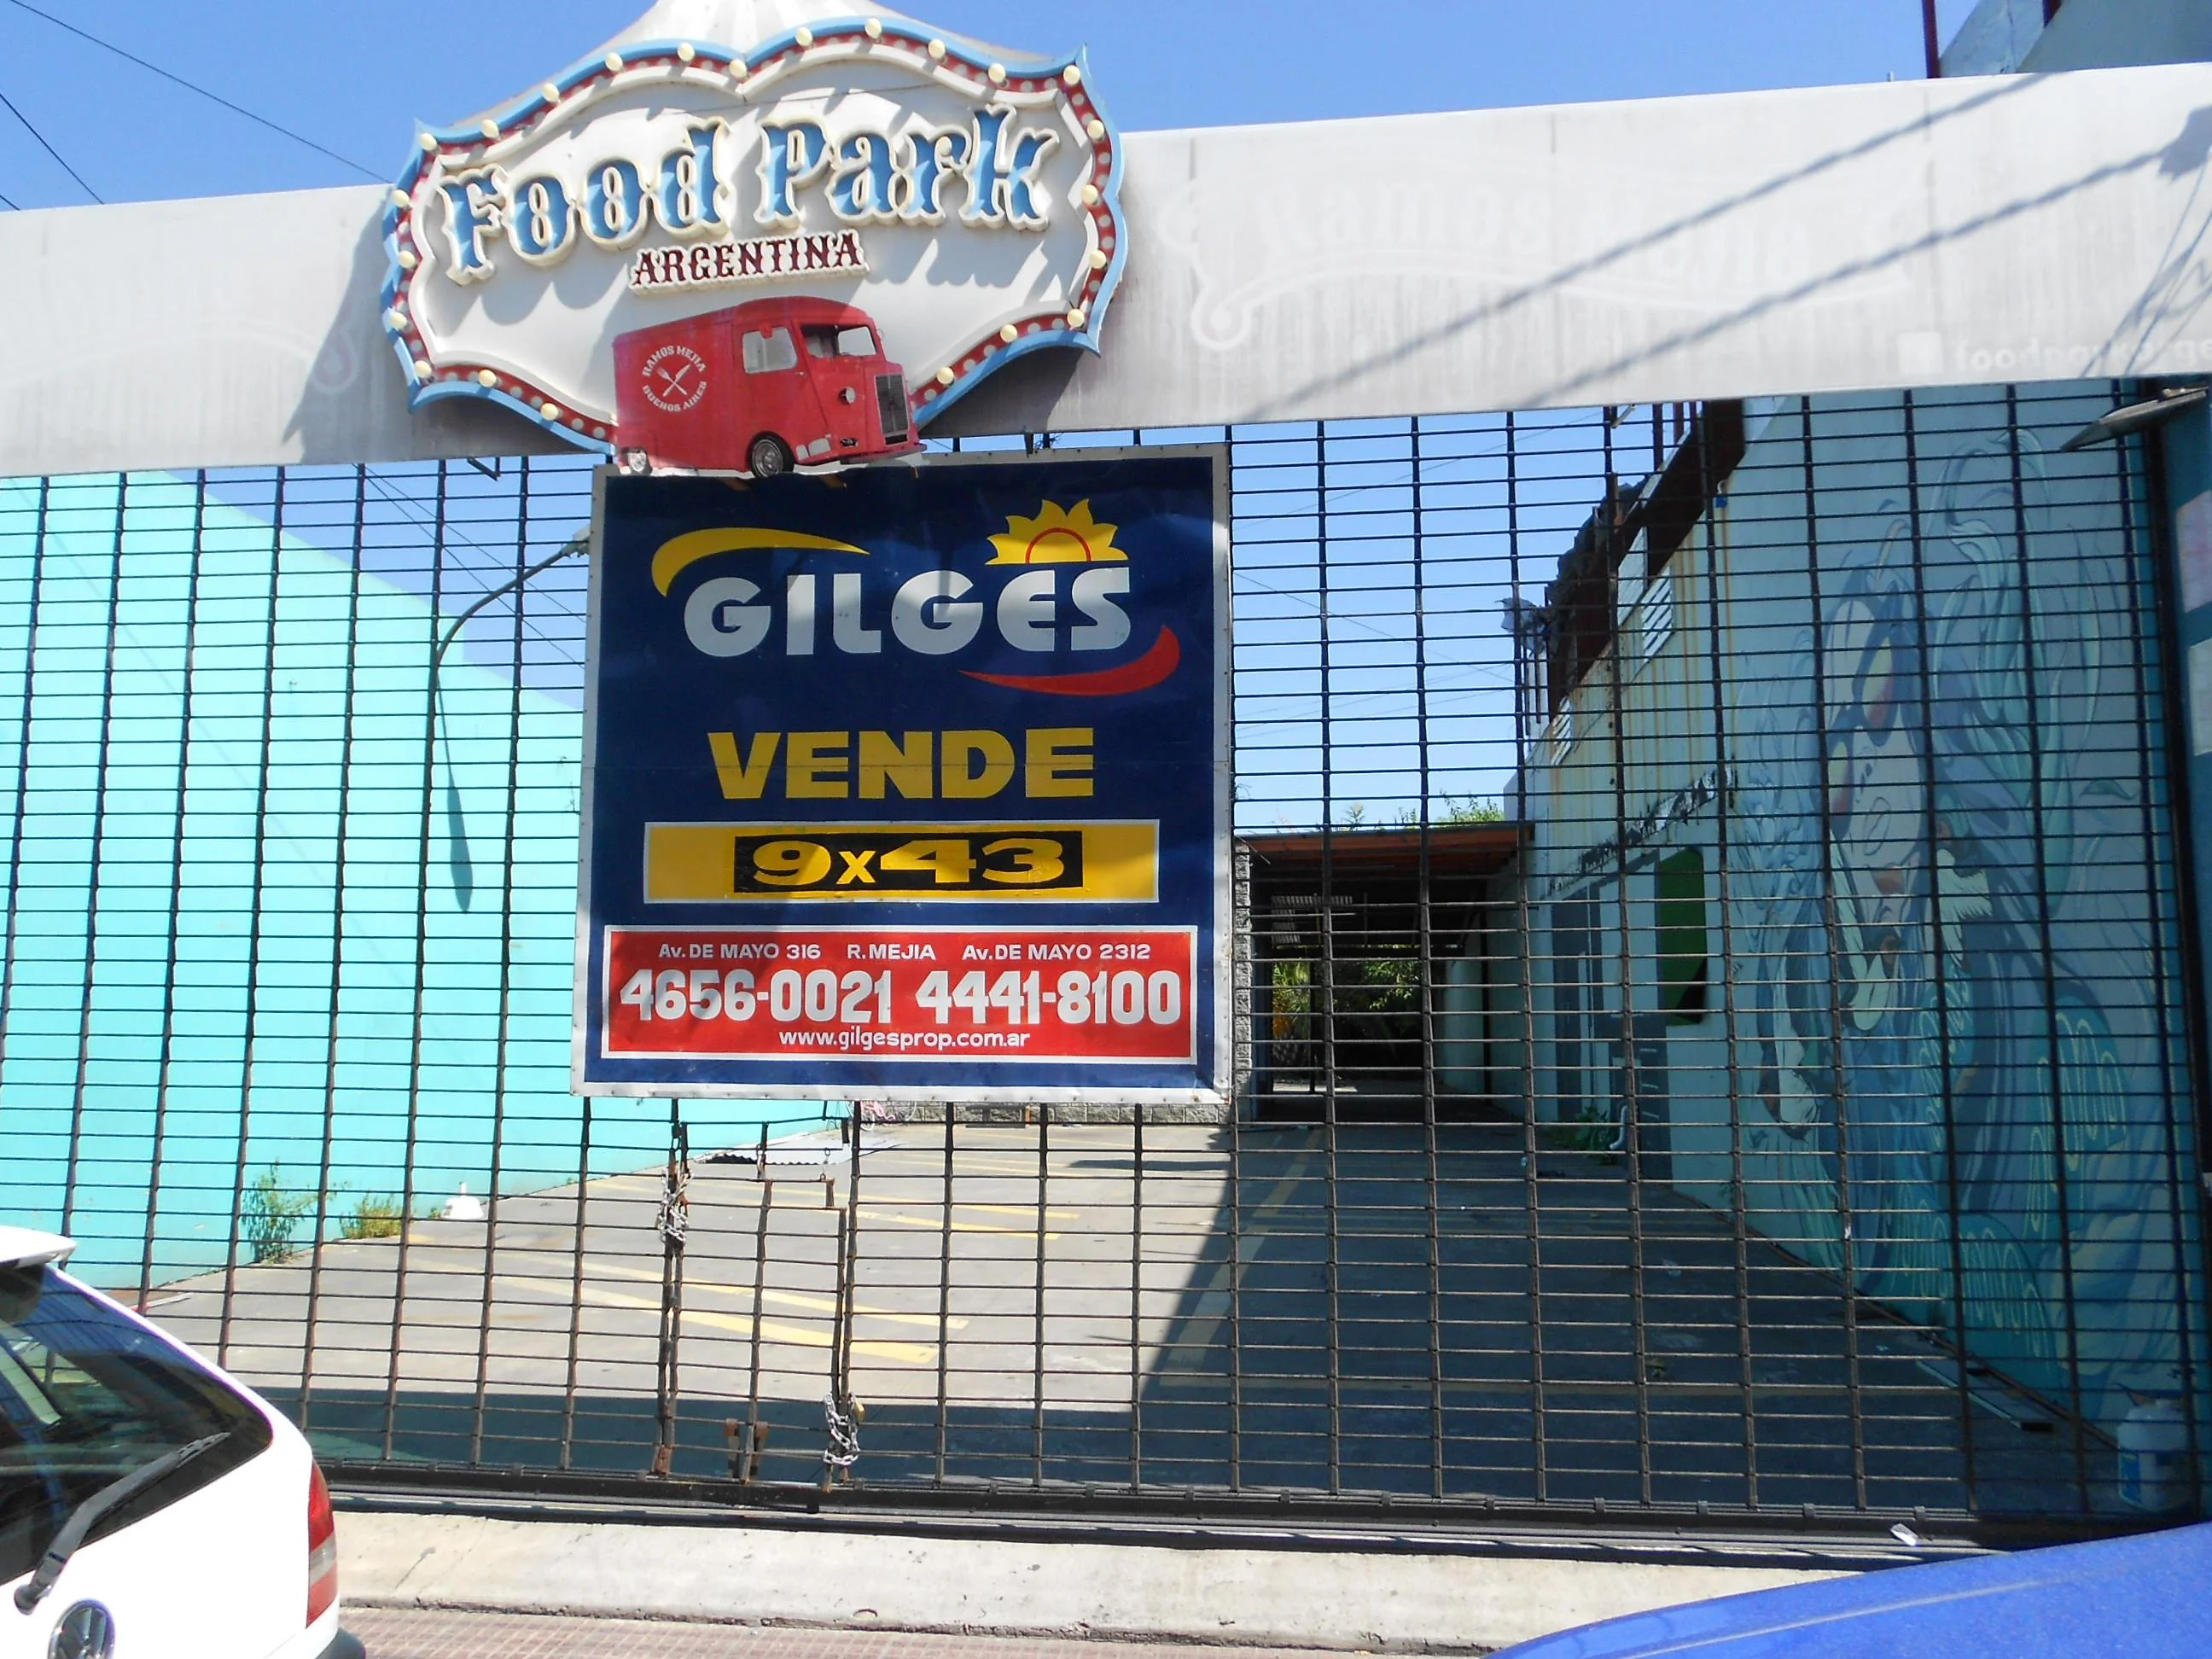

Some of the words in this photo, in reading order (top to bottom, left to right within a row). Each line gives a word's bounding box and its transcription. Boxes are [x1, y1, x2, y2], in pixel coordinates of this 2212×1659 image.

[438, 116, 735, 285] Food
[754, 103, 1060, 231] Park
[632, 230, 867, 290] ARGENTINA
[642, 345, 675, 377] RAMOS
[677, 345, 707, 373] MEJIA
[642, 385, 681, 412] BUENOS
[683, 381, 707, 410] AIRES
[684, 566, 1132, 658] GILGES
[707, 727, 1094, 800] VENDE
[720, 942, 780, 959] MAYO
[786, 943, 821, 960] 316
[1027, 943, 1092, 961] MAYO
[1099, 943, 1151, 960] 2312
[620, 968, 893, 1024] 4656-0021
[915, 969, 1181, 1025] 4441-8100
[778, 1025, 1031, 1051] www.gilgesprop.com.ar
